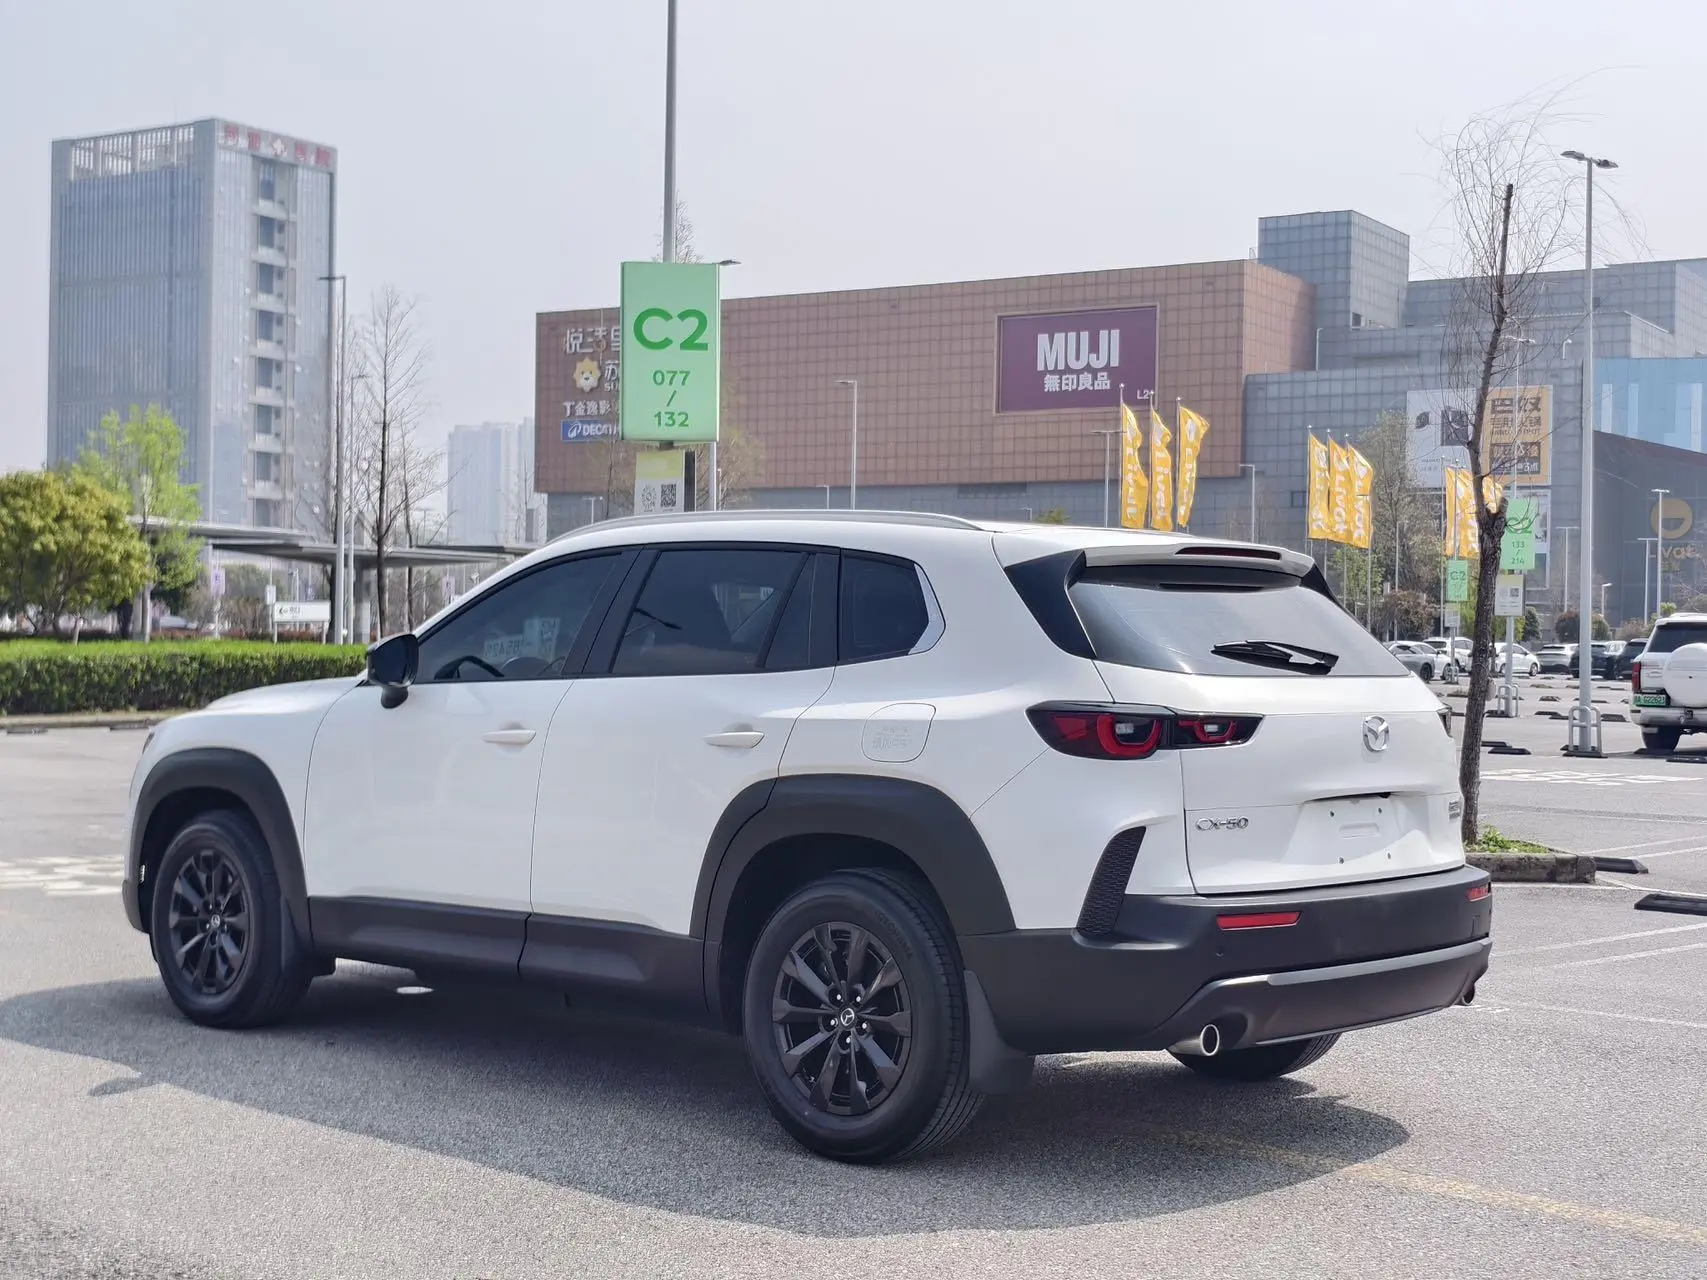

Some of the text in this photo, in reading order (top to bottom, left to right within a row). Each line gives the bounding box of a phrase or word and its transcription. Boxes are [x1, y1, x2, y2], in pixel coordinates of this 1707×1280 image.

[633, 307, 709, 351] C2
[1037, 329, 1120, 371] MUJI
[653, 370, 691, 386] 077
[1044, 372, 1111, 392] 無印良品
[654, 411, 689, 428] 132
[1506, 517, 1532, 534] C2
[1196, 816, 1249, 831] CX-50
